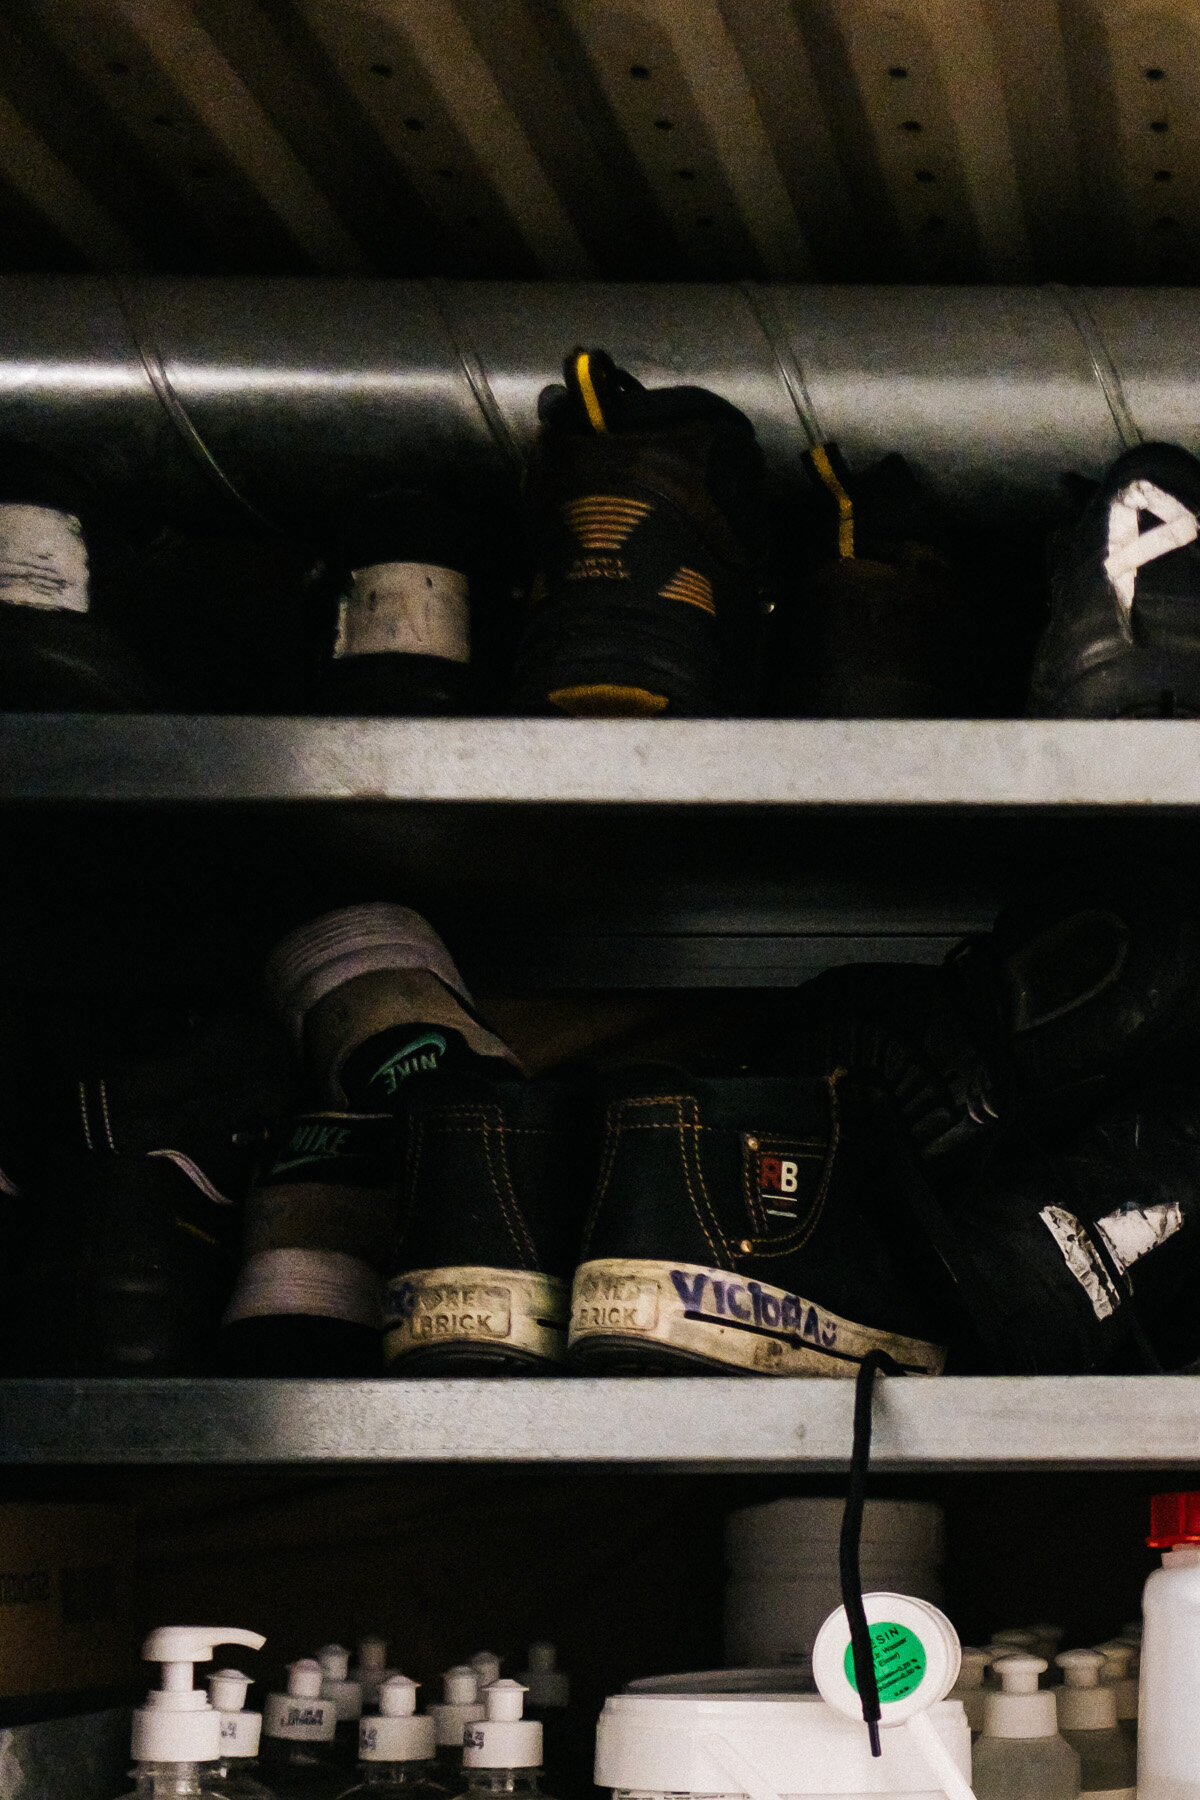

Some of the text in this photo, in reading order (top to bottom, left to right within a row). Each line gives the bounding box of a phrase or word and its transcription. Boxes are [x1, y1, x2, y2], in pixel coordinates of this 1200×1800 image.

[383, 1052, 438, 1096] NIKE
[289, 1126, 351, 1150] NIKE
[420, 1313, 492, 1334] BRICK
